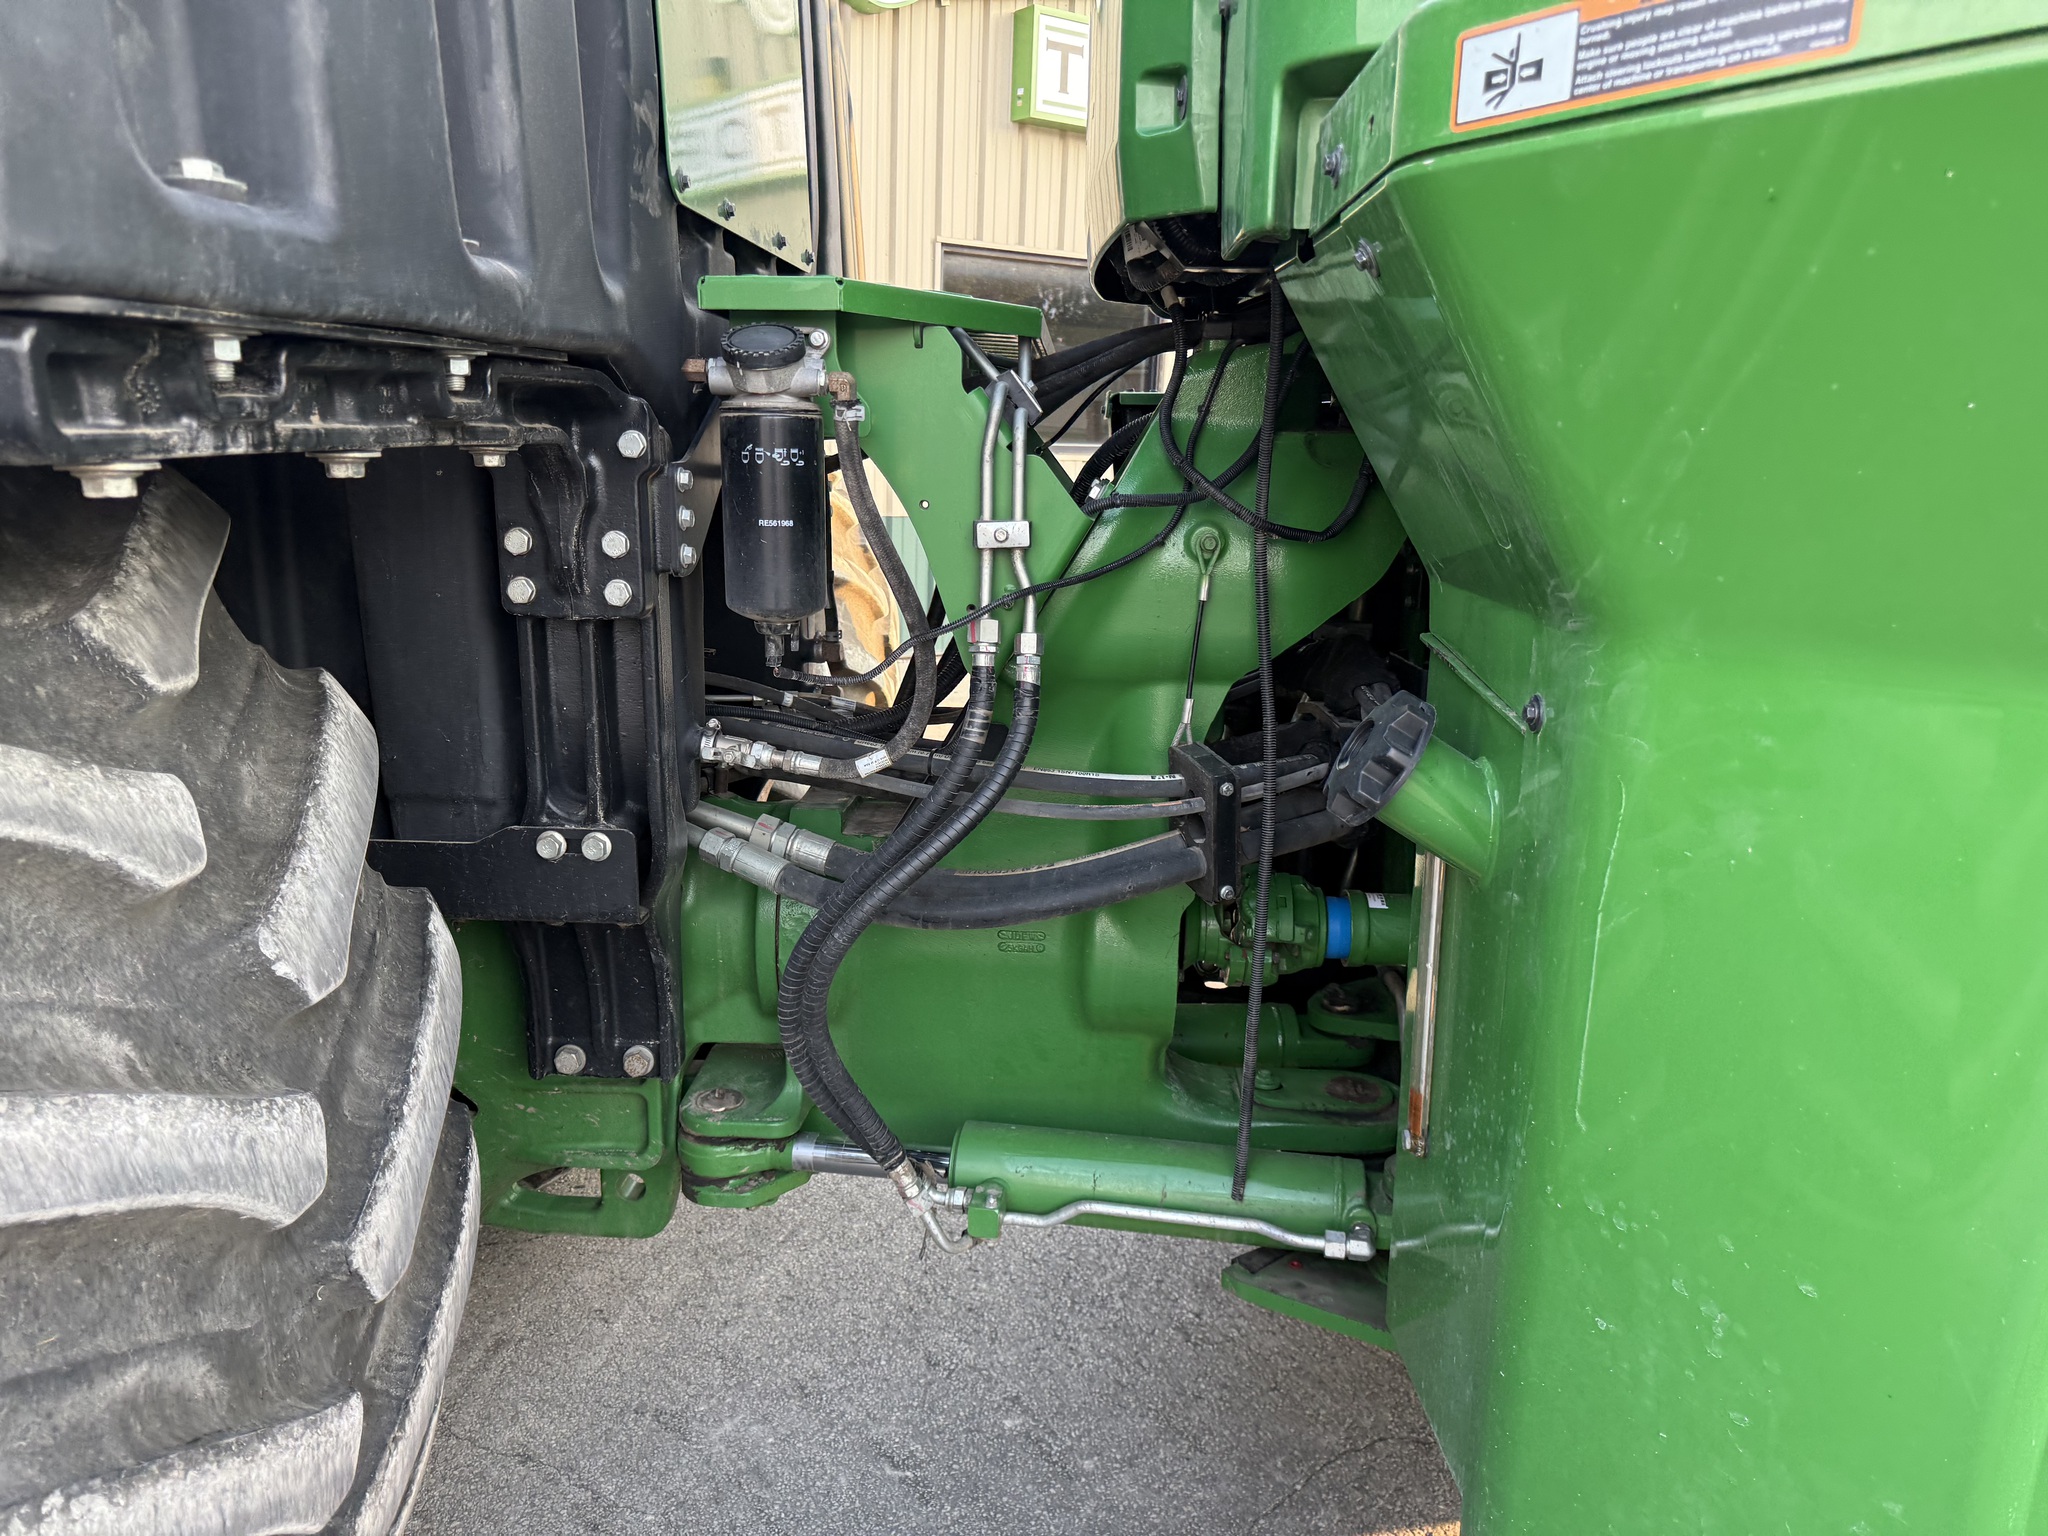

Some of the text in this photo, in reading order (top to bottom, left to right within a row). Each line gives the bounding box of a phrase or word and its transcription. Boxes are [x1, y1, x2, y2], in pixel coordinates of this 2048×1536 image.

[1576, 56, 1607, 72] engine
[1608, 54, 1620, 64] or
[1620, 45, 1657, 61] moving
[1657, 35, 1699, 52] steering
[1578, 47, 1601, 60] Make
[1602, 42, 1624, 55] sure
[1625, 33, 1658, 50] people
[1659, 30, 1676, 41] are
[1677, 24, 1703, 37] clear
[1704, 18, 1716, 30] of
[1717, 9, 1763, 28] machine
[1046, 37, 1084, 94] T
[1573, 82, 1601, 96] center
[1602, 79, 1613, 90] of
[1613, 71, 1653, 87] machine
[1653, 69, 1665, 79] or
[1665, 56, 1727, 78] transporting
[1727, 51, 1742, 64] on
[1743, 50, 1752, 60] a
[1575, 71, 1603, 86] Attach
[1604, 63, 1642, 79] steering
[1684, 46, 1717, 62] before
[1717, 33, 1776, 55] performing
[759, 519, 794, 527] RE561968
